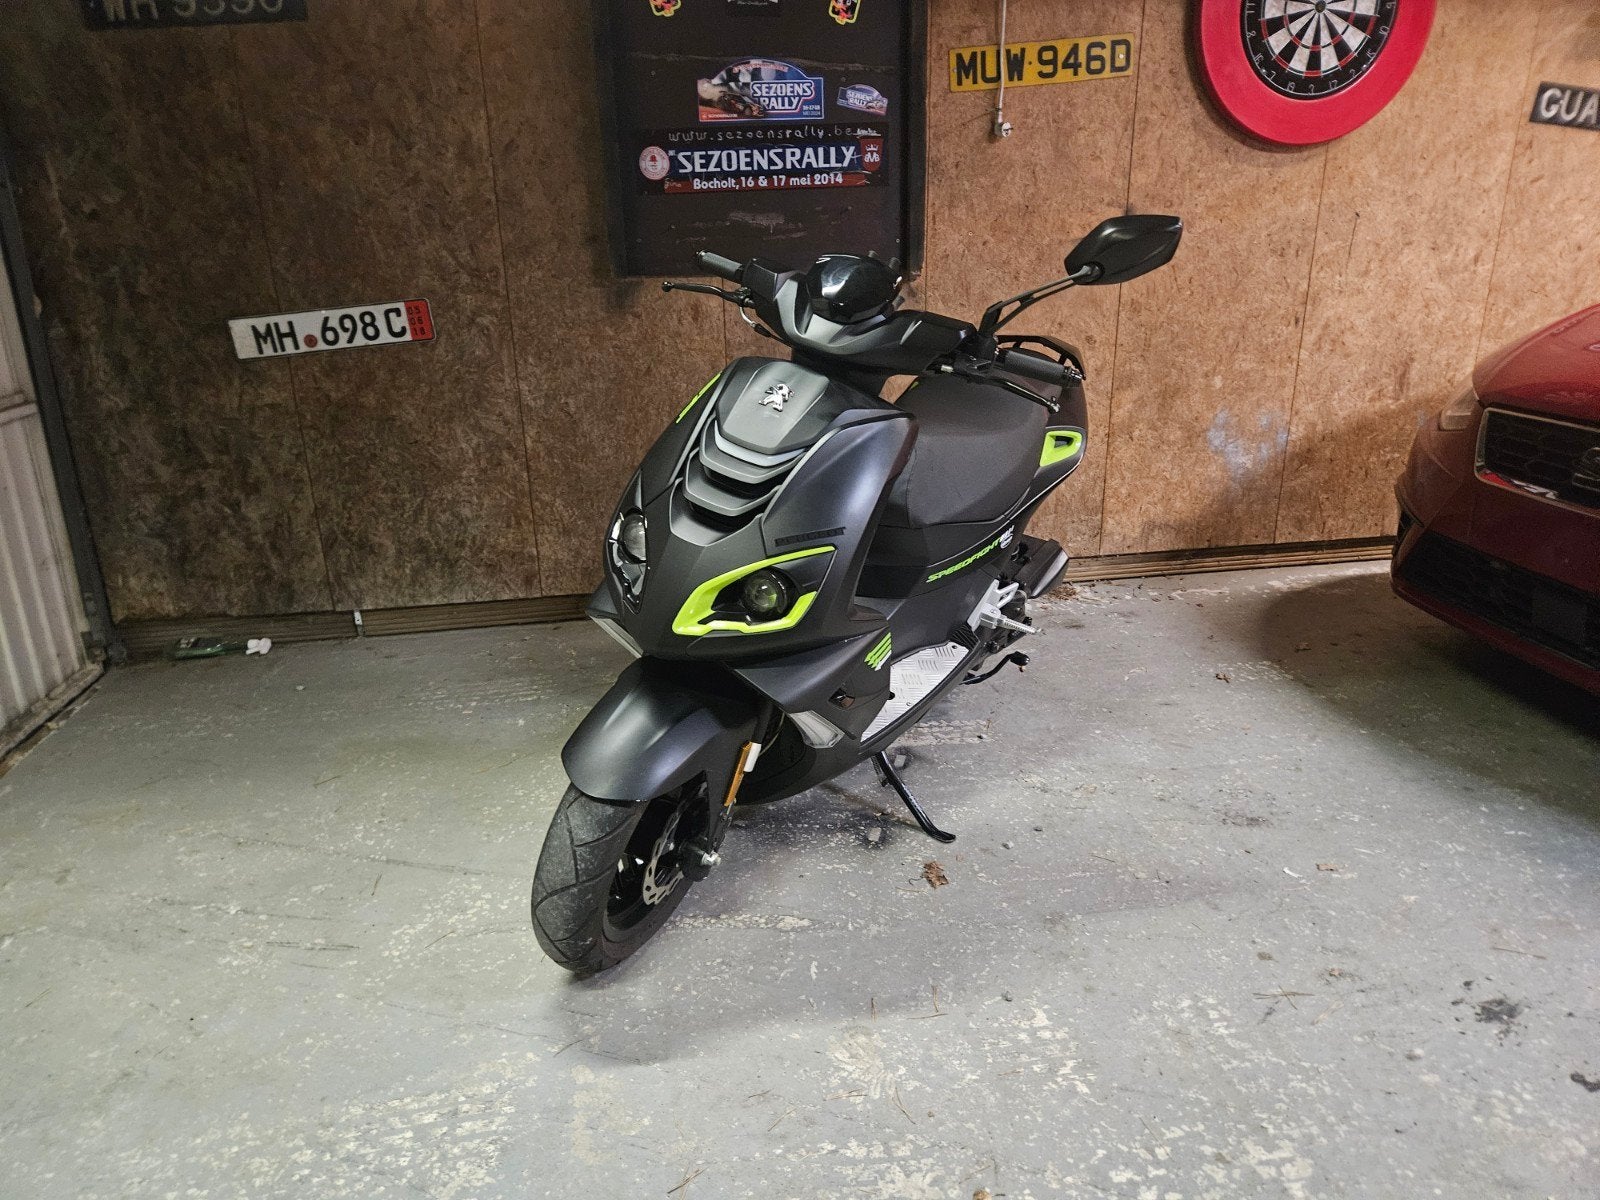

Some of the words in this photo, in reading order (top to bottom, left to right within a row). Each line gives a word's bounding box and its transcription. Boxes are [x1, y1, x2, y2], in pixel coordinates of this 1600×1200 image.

[751, 82, 813, 96] SEZOENS
[760, 96, 801, 110] RALLY
[668, 125, 852, 141] www.sezoensrally.be
[677, 146, 856, 173] SEZOENSRALLY
[758, 175, 768, 187] &
[772, 175, 786, 187] 17
[789, 174, 811, 186] mei
[814, 173, 843, 185] 2014
[251, 320, 300, 355] MH
